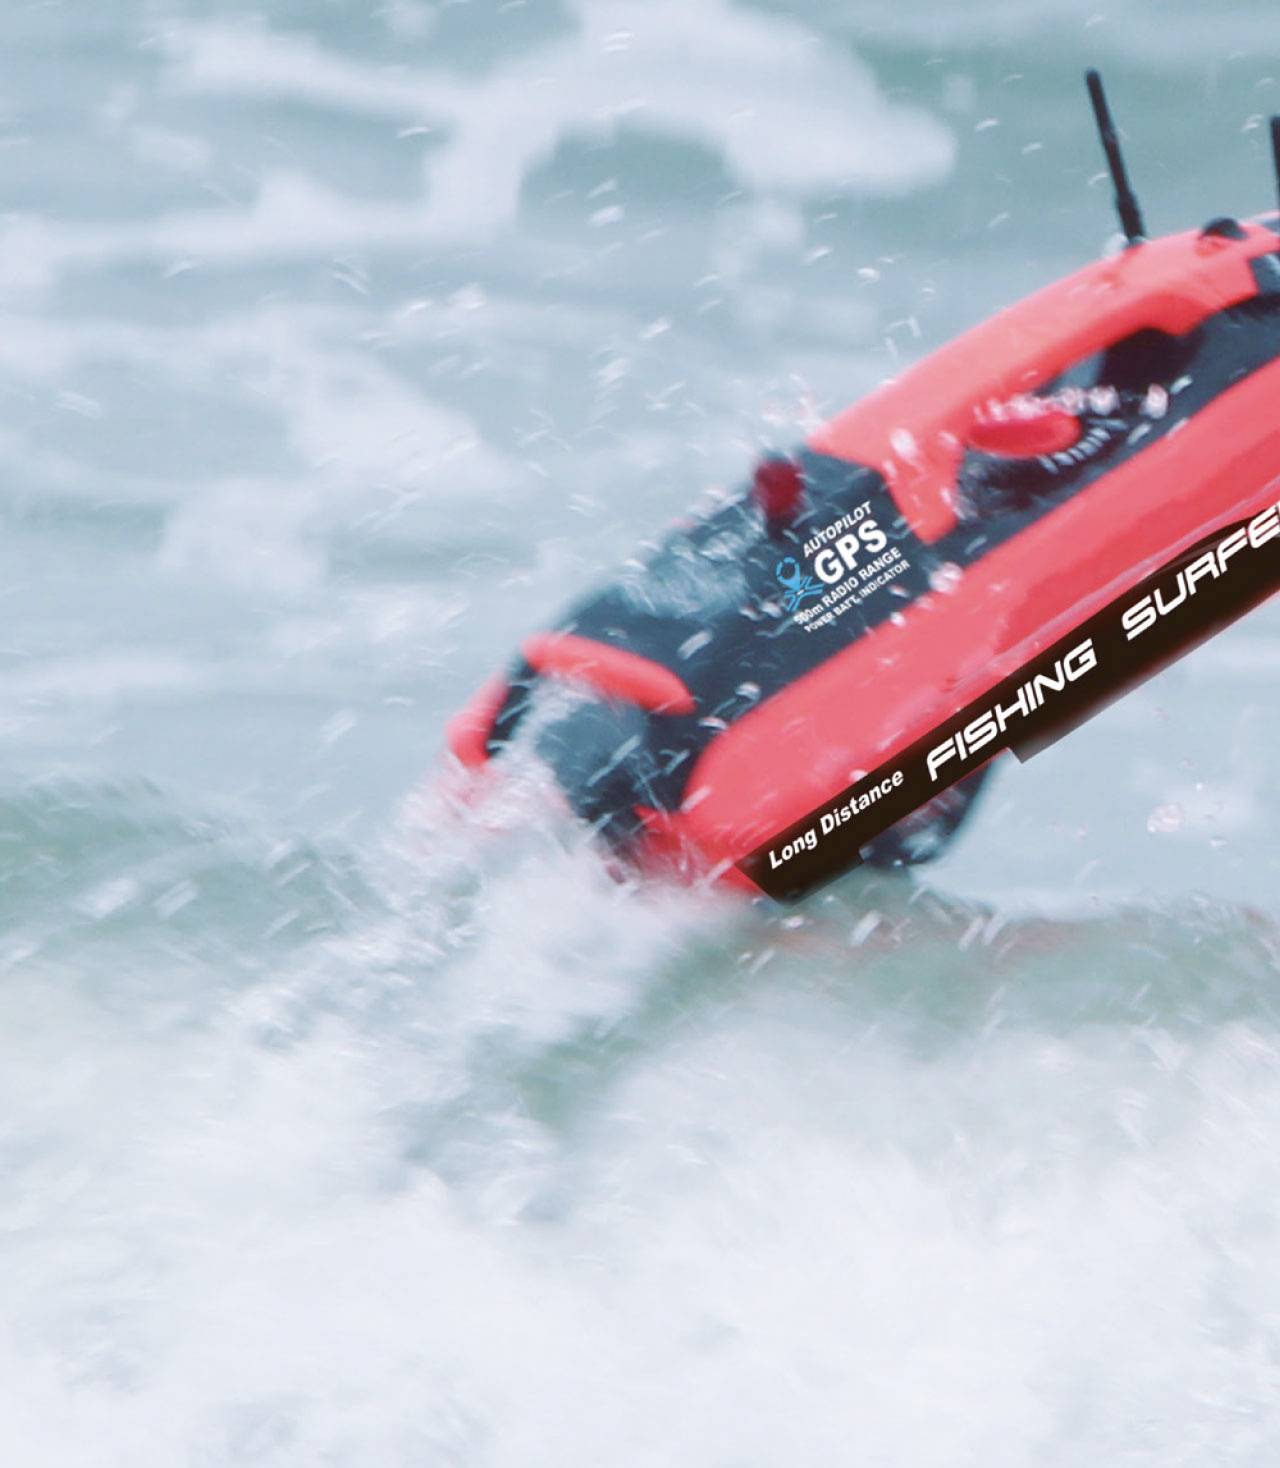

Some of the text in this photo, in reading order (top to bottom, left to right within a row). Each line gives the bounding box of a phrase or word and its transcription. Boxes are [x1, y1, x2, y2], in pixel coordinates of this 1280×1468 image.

[802, 501, 872, 558] AUTOPILOT
[814, 519, 887, 584] GPS
[794, 547, 902, 625] 500m RADIO RANGE
[804, 611, 835, 632] POWER
[858, 560, 910, 598] INDICATOR
[769, 827, 818, 869] Long
[820, 768, 904, 835] Distance
[927, 638, 1098, 782] FISHING
